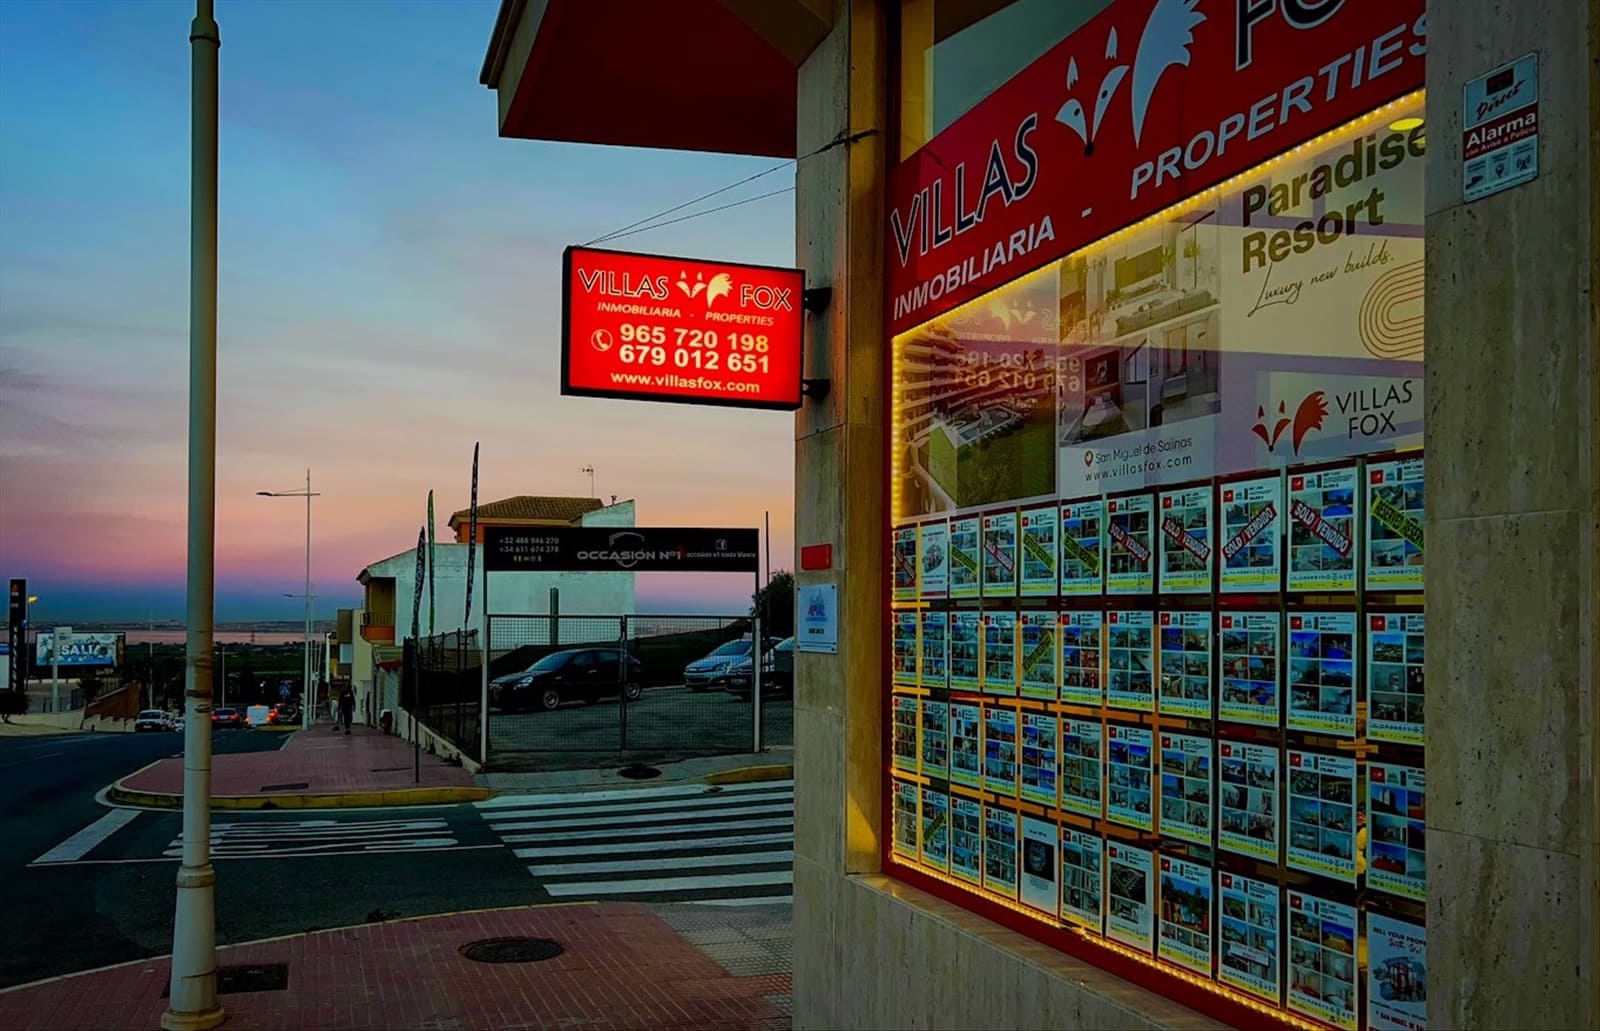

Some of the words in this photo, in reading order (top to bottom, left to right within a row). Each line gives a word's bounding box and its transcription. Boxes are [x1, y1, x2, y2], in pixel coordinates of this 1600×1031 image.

[1465, 112, 1537, 149] Alarma
[890, 112, 1038, 268] VILLAS
[1242, 124, 1425, 228] Paradise
[1242, 187, 1385, 274] Resort
[893, 215, 1056, 321] INMOBILIARIA
[578, 268, 669, 300] VILLAS
[740, 284, 793, 312] FOX
[1247, 262, 1305, 318] Luxury
[1310, 267, 1339, 285] new
[597, 302, 682, 318] INMOBILIARIA
[704, 311, 776, 327] PROPERTIES
[619, 323, 667, 345] 965
[673, 328, 719, 350] 720
[726, 333, 770, 353] 198
[619, 344, 667, 366] 679
[673, 348, 720, 371] 012
[726, 353, 770, 374] 651
[610, 371, 761, 393] www.villasfox.com
[1335, 379, 1412, 415] VILLAS
[1348, 410, 1397, 440] FOX
[1084, 454, 1193, 482] www.villasfox.com
[1095, 452, 1111, 464] San
[1142, 442, 1156, 455] de
[1109, 521, 1125, 540] SOLD
[1165, 520, 1180, 538] SOLD
[1224, 538, 1242, 559] SOLD
[1246, 506, 1274, 538] VENDIDO
[1295, 502, 1316, 526] SOLD
[1317, 519, 1350, 554] VENDIDO
